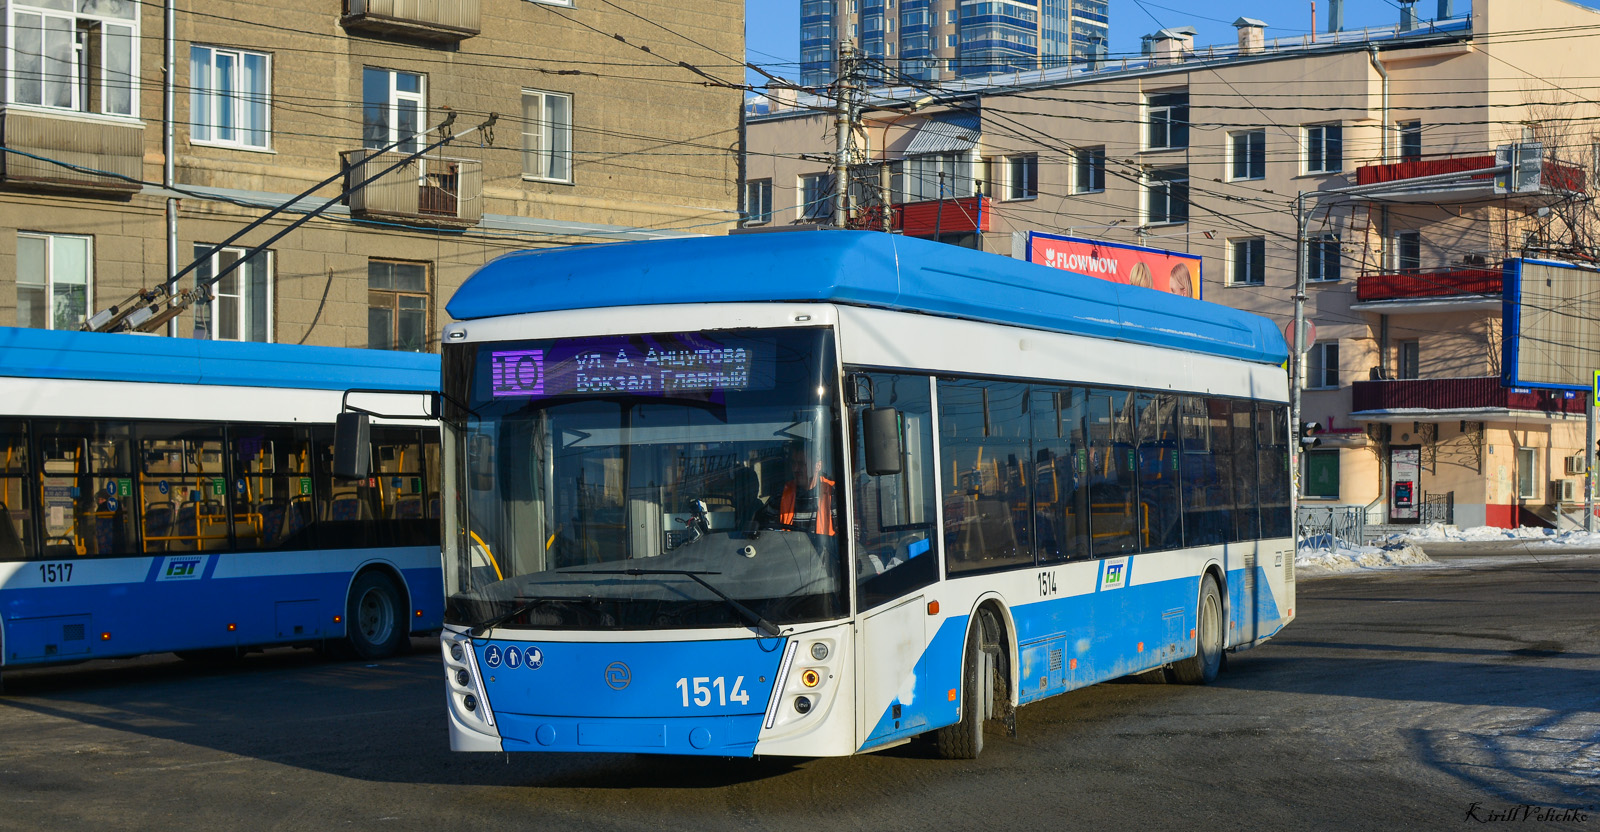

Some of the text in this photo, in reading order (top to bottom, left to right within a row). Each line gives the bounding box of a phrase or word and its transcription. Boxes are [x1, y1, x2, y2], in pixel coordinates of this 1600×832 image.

[1057, 252, 1118, 275] FLOWWOW
[613, 348, 635, 368] А.
[643, 347, 747, 368] Анцупова
[493, 355, 538, 392] 10
[576, 365, 748, 393] Вокзал Главный
[39, 563, 73, 584] 1517
[1038, 570, 1057, 597] 1514
[676, 675, 750, 708] 1514
